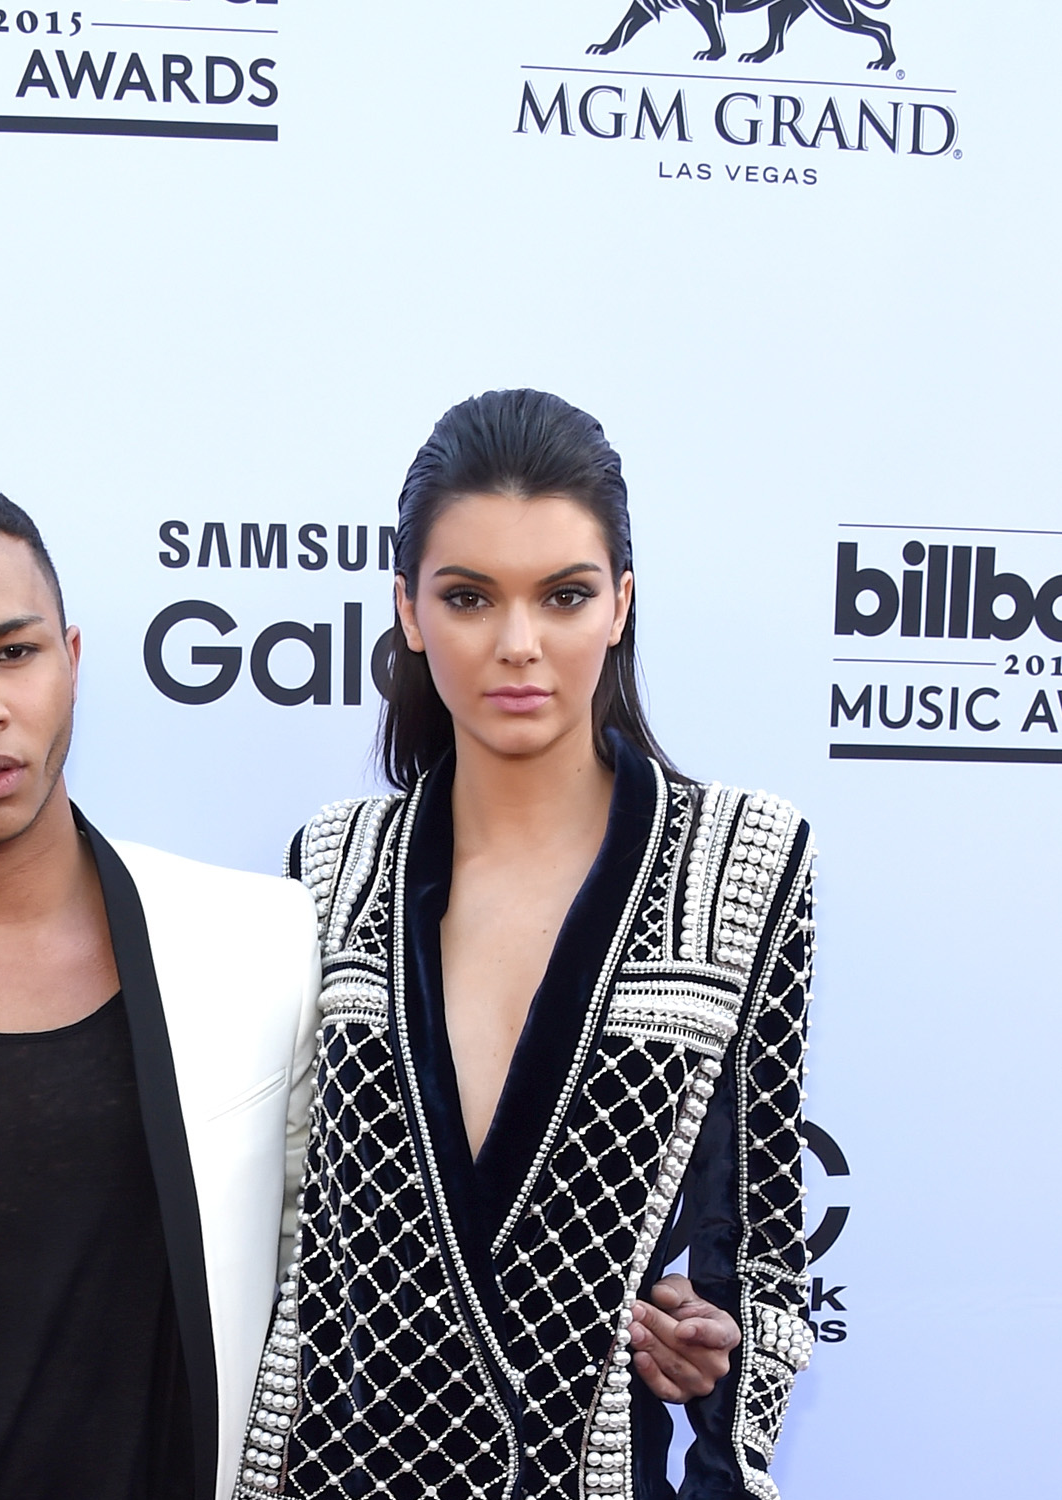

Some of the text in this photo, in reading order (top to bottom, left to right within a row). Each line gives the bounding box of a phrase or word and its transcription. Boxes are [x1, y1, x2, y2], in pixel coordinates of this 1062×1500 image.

[15, 48, 279, 108] AWARDS
[512, 79, 960, 157] MGM GRAND
[658, 161, 819, 186] LAS VEGAS
[158, 520, 397, 572] SAMSU
[834, 540, 1062, 642] billb
[143, 599, 397, 707] Gal
[1004, 654, 1062, 676] 201
[830, 683, 1001, 732] MUSIC
